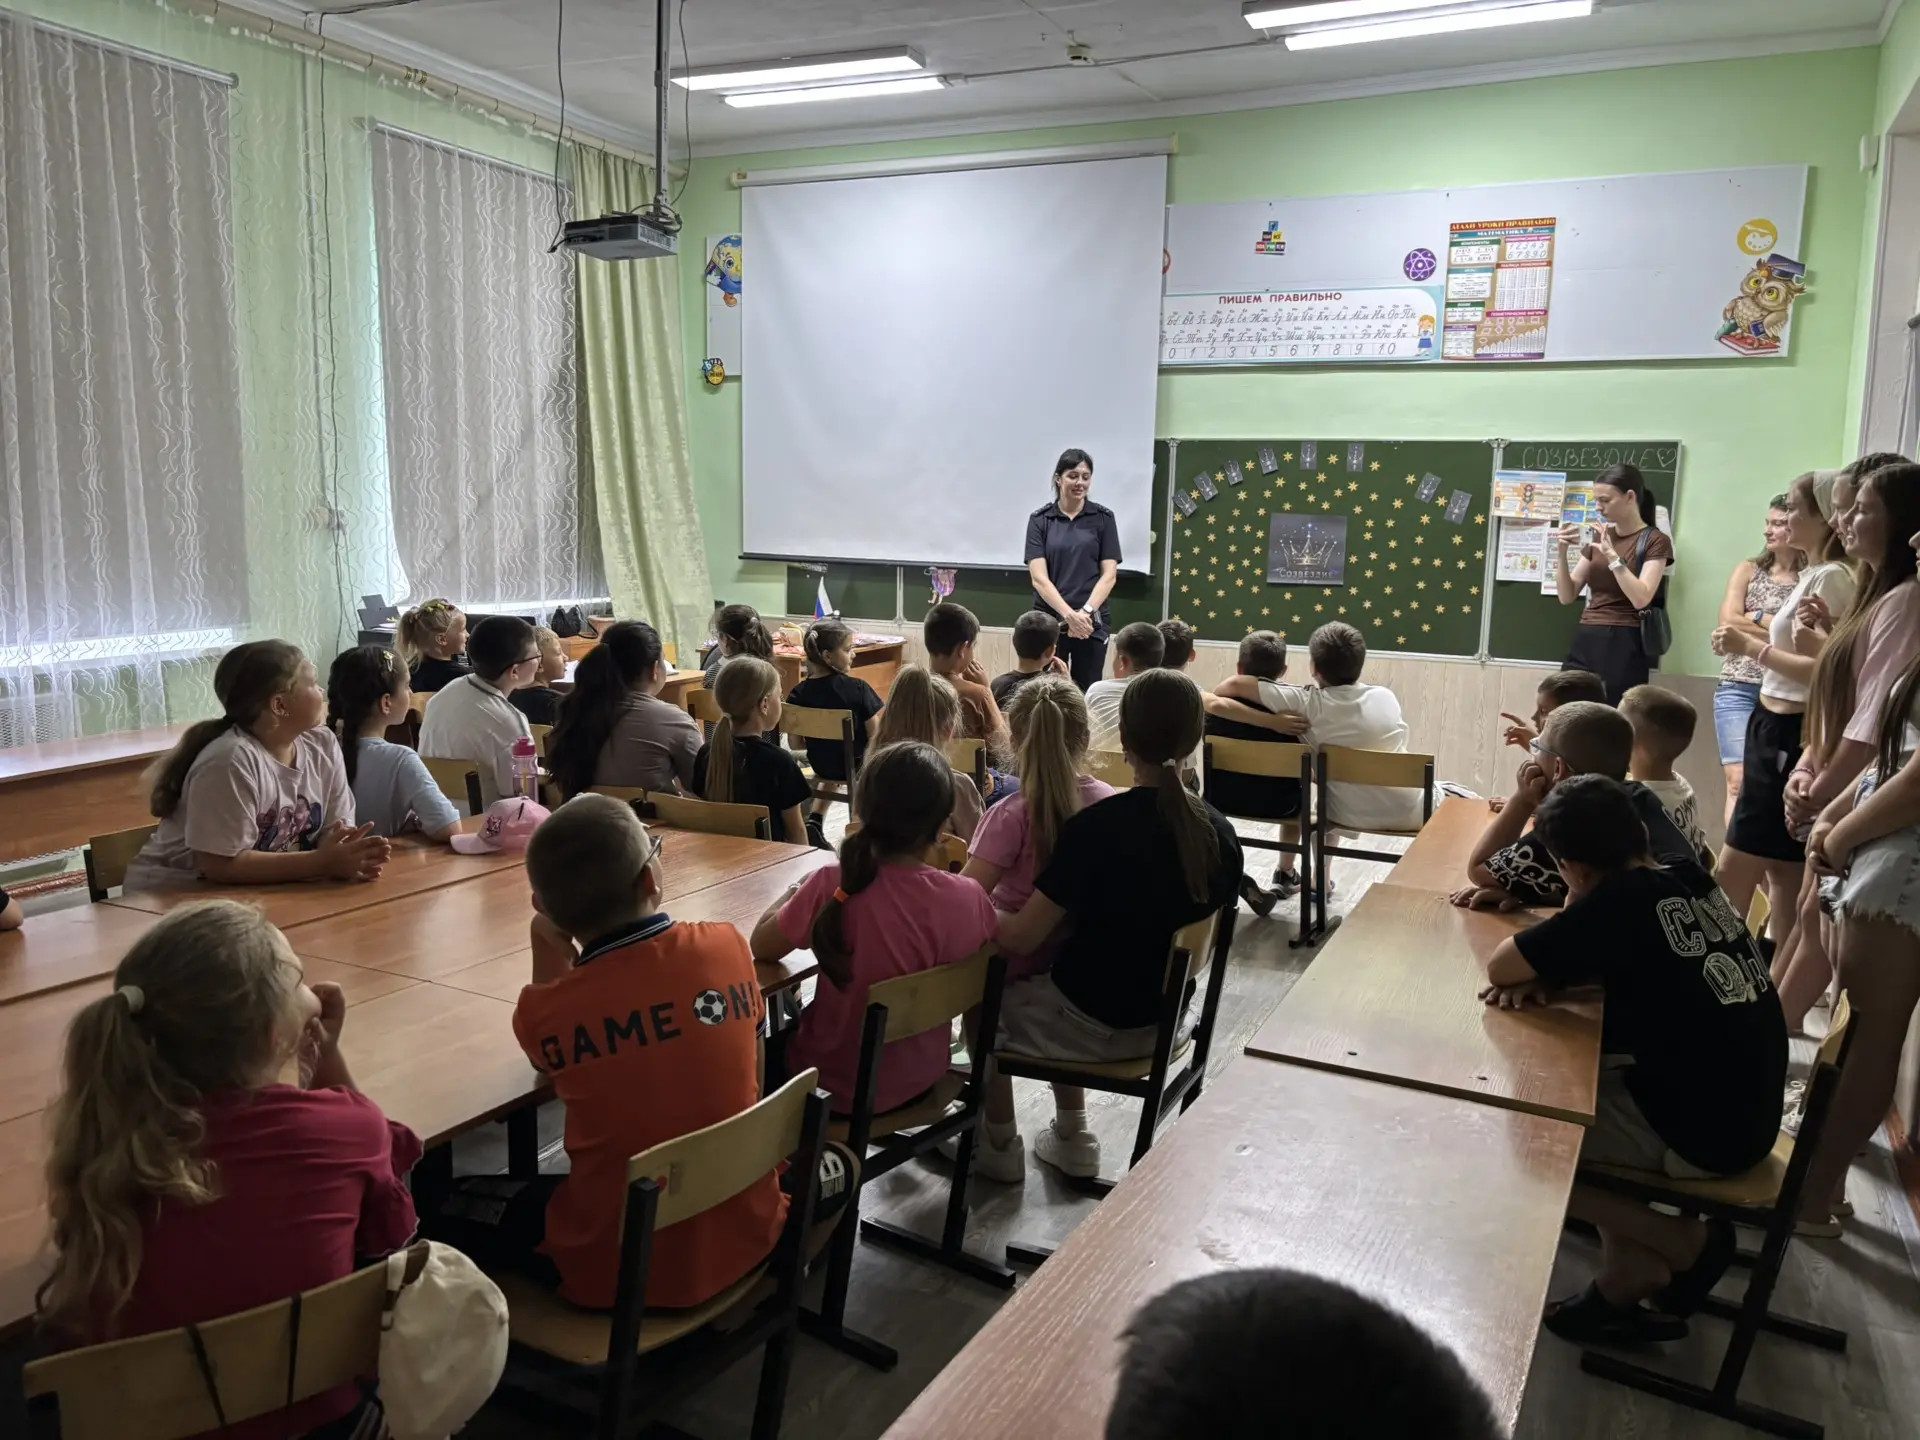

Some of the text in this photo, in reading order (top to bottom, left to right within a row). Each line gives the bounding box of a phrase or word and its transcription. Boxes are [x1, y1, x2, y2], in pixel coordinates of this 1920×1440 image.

[1219, 292, 1342, 304] ПИШЕМ ПРАВИЛЬНО
[1169, 343, 1396, 359] 0 1 2 3 4 5 6 7 8 9 10
[1522, 446, 1653, 468] СОЗВЕЗДИЕ
[541, 1002, 682, 1071] GAME
